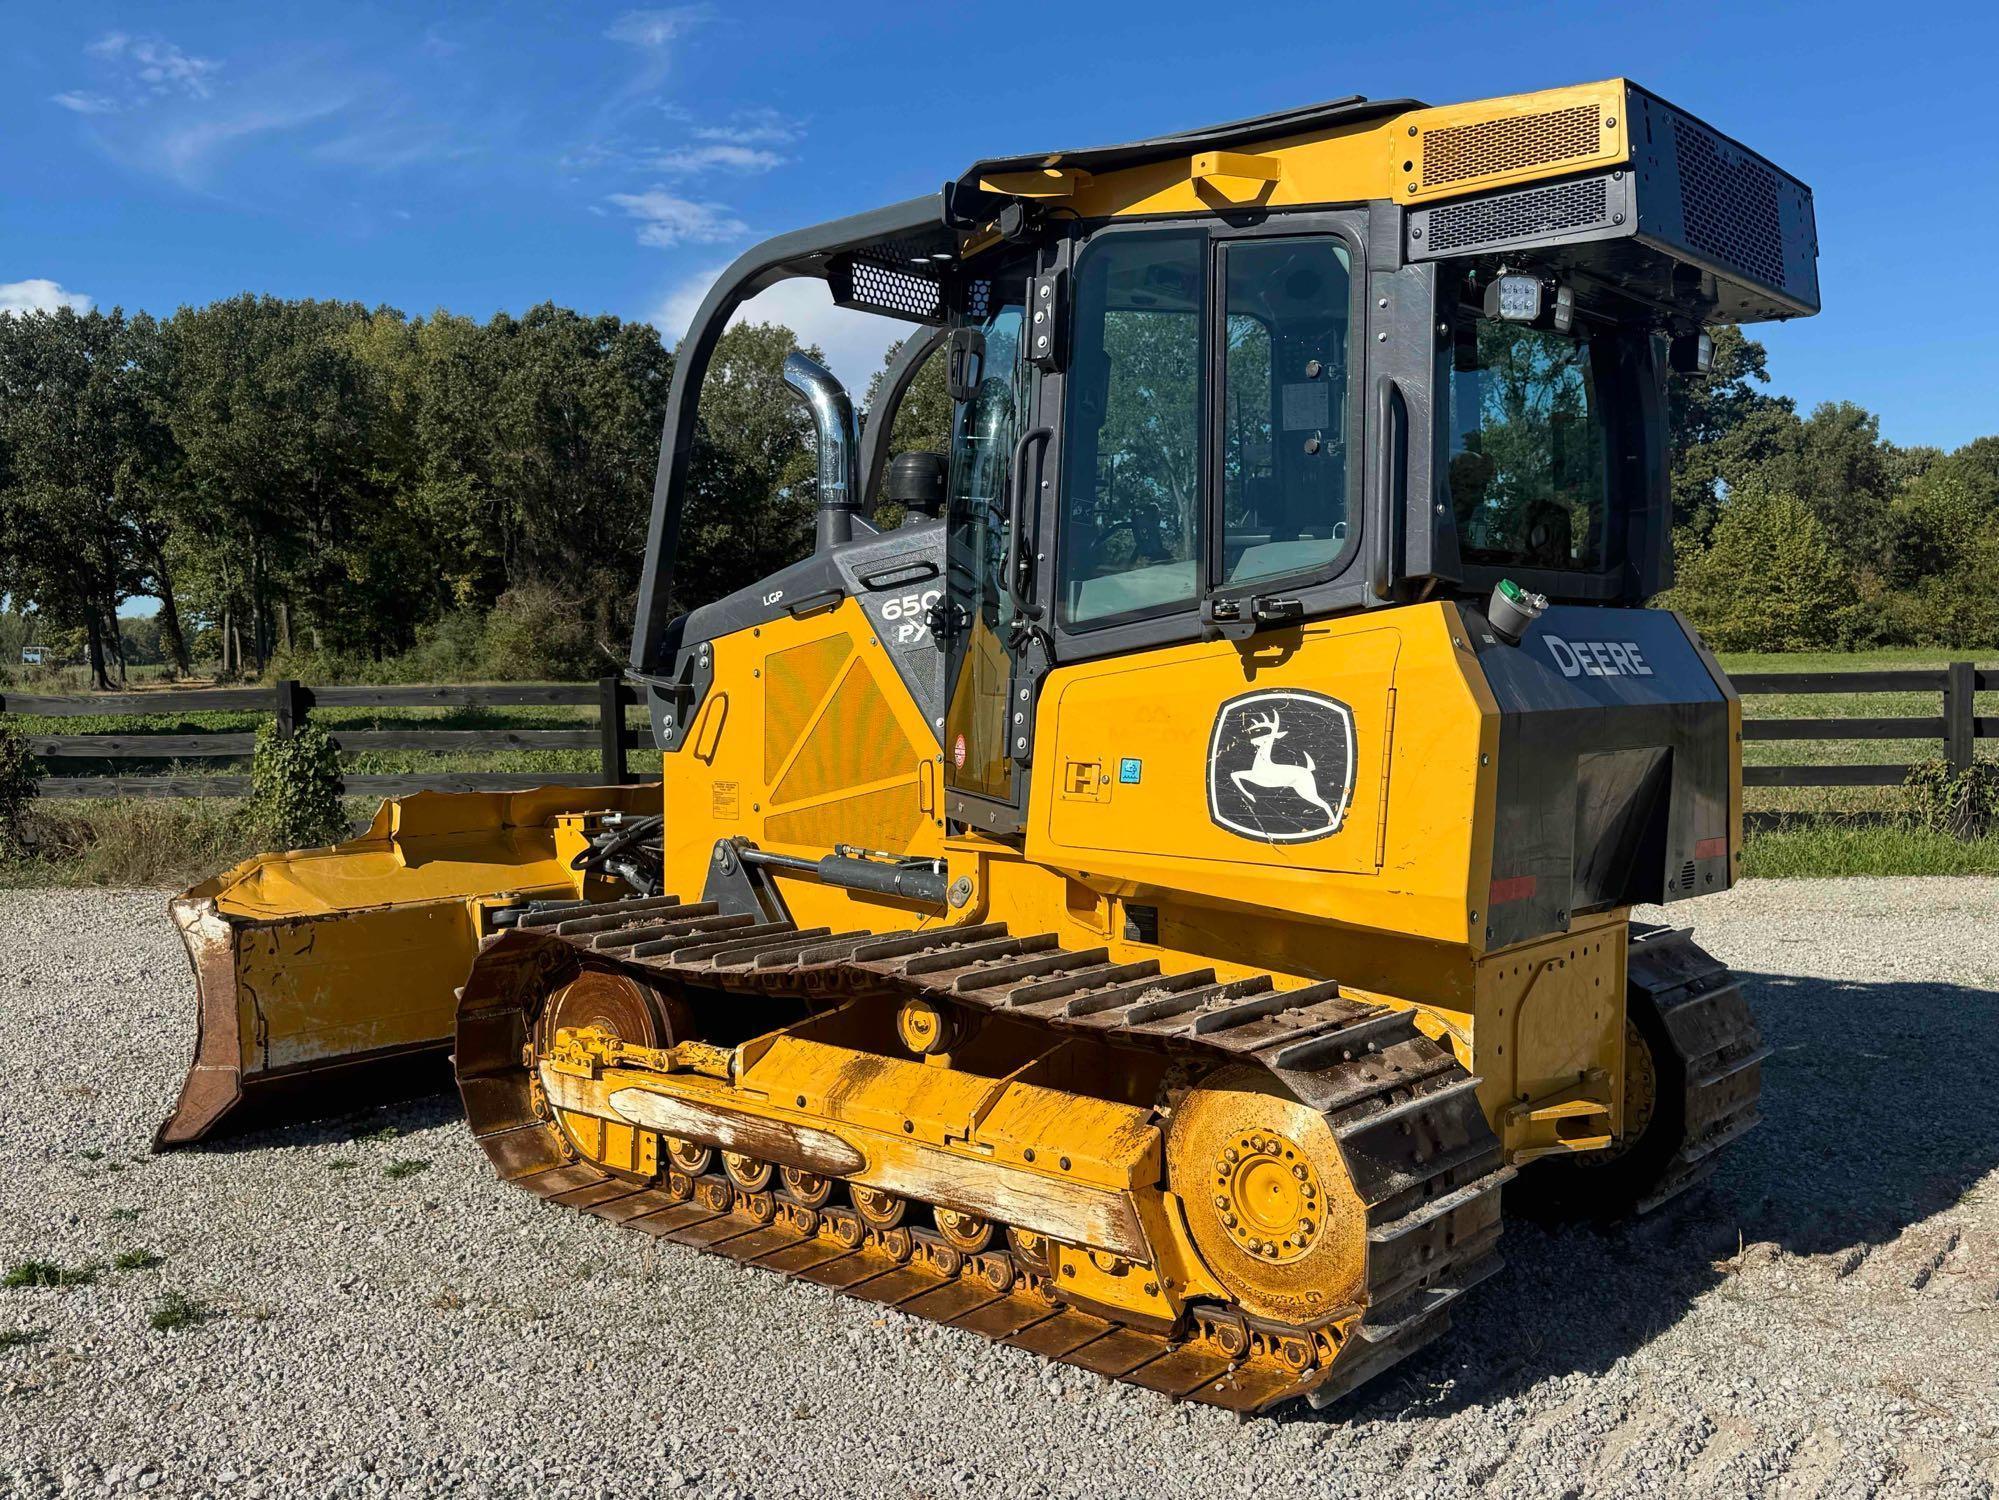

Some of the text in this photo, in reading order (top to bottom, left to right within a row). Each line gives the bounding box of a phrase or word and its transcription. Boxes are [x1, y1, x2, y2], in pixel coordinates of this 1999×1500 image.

[763, 590, 784, 606] LGP
[881, 590, 942, 620] 650
[1542, 635, 1654, 677] DEERE
